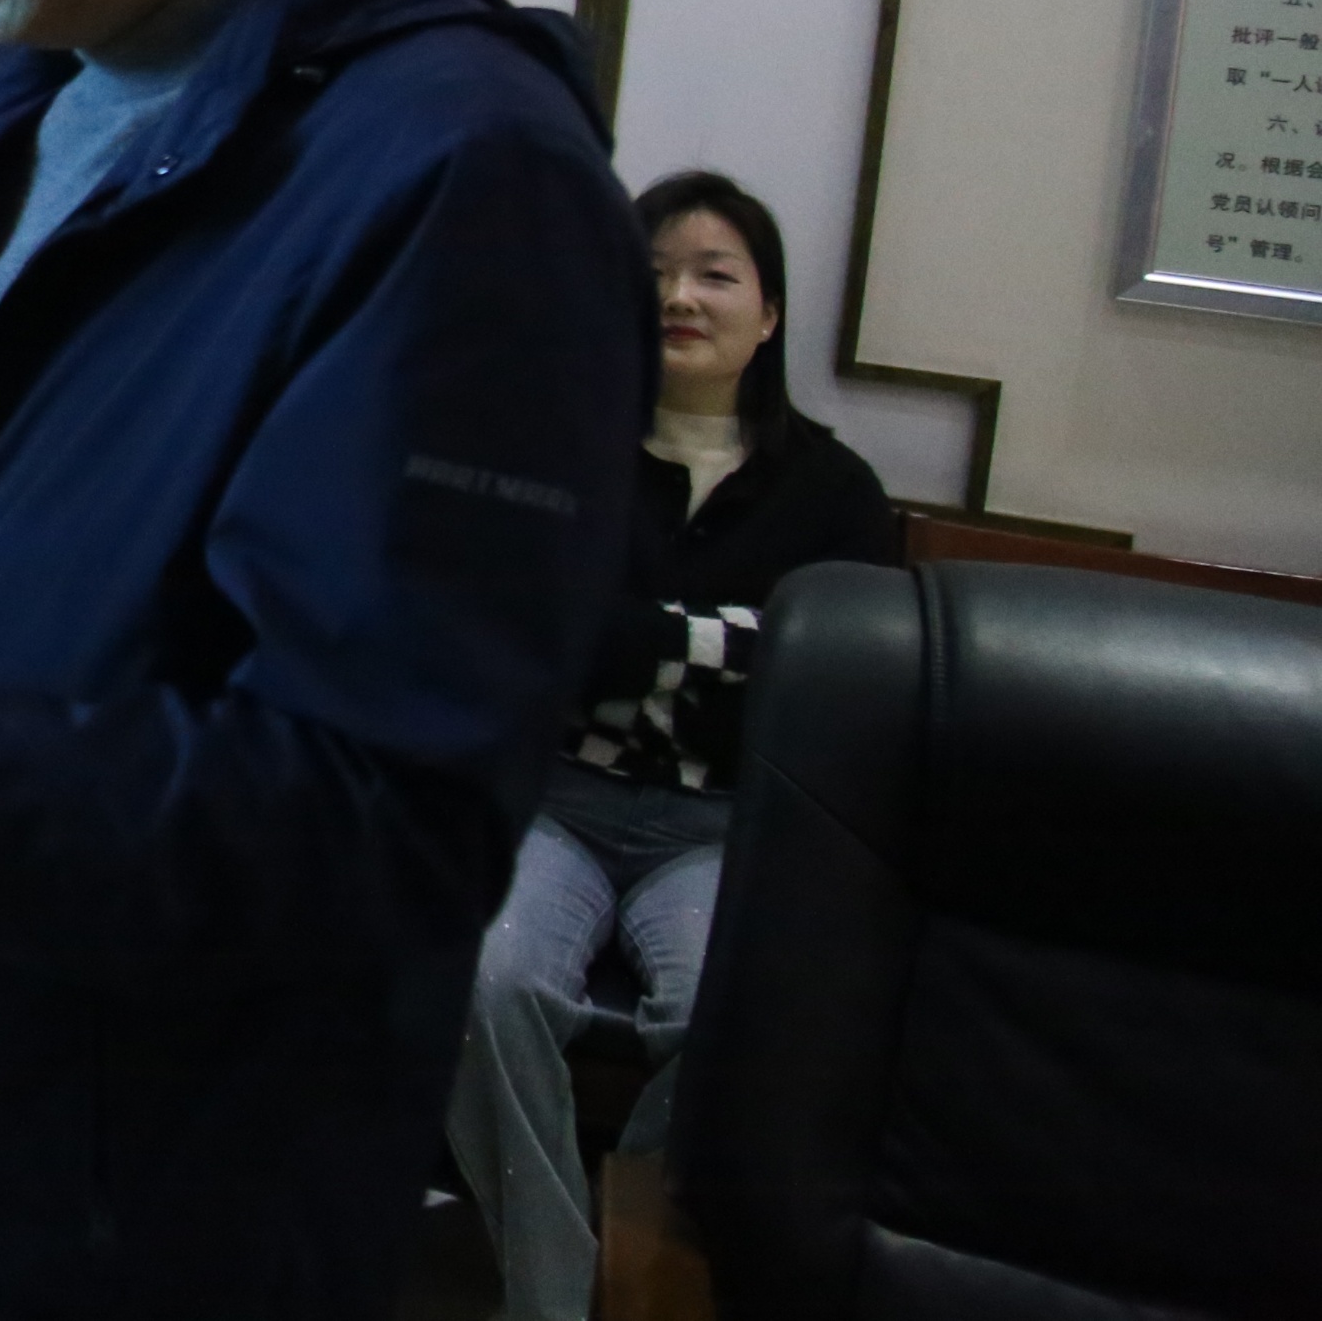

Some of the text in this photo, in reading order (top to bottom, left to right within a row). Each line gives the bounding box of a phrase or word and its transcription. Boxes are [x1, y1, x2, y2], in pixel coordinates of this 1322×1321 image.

[1231, 26, 1320, 51] 批评一般
[1210, 193, 1321, 222] 党员认领问
